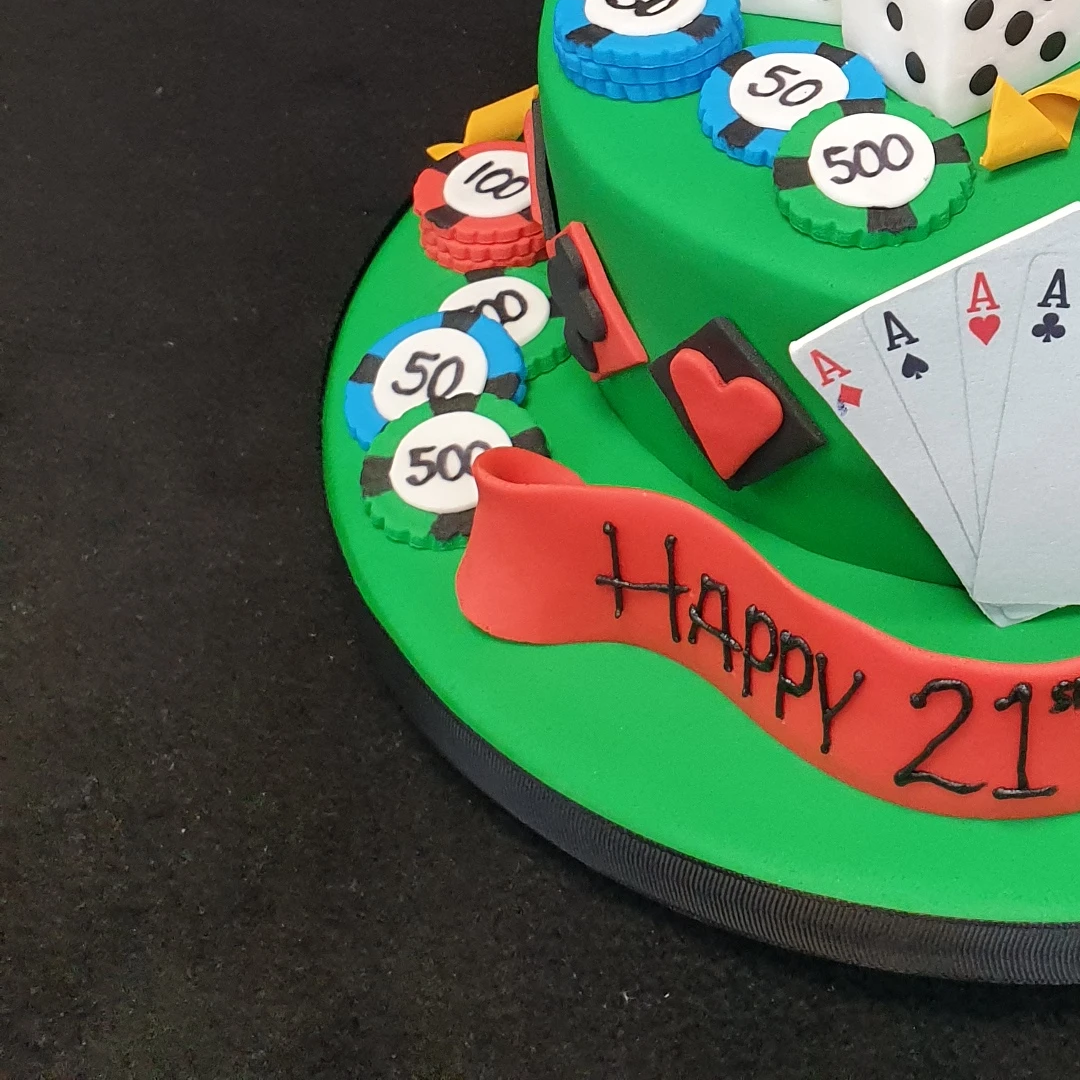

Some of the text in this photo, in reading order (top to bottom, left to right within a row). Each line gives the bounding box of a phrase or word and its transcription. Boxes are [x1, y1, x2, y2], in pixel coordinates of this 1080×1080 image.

[747, 64, 822, 107] 50
[463, 160, 529, 200] 100
[823, 133, 915, 185] 500
[966, 271, 1000, 314] A
[1037, 268, 1071, 309] A
[882, 310, 920, 351] A
[391, 351, 465, 399] 50
[810, 348, 852, 386] A
